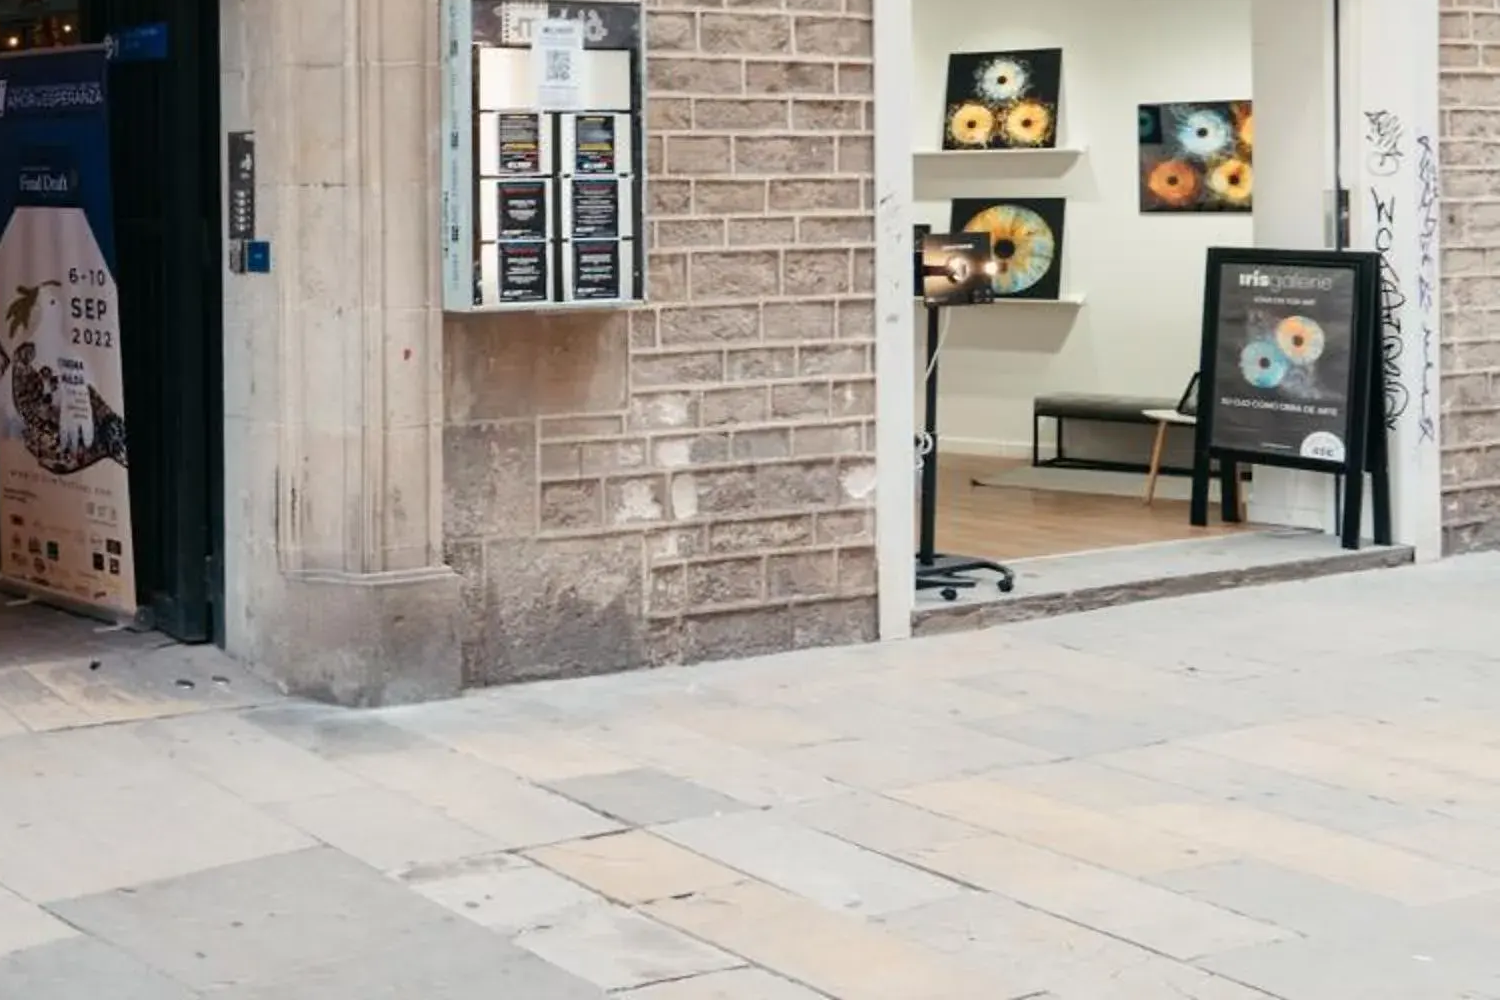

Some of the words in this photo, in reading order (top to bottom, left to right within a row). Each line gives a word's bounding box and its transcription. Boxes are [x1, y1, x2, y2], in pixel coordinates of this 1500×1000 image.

[69, 267, 106, 287] 6-10
[71, 298, 107, 320] SEP
[72, 328, 113, 348] 2022
